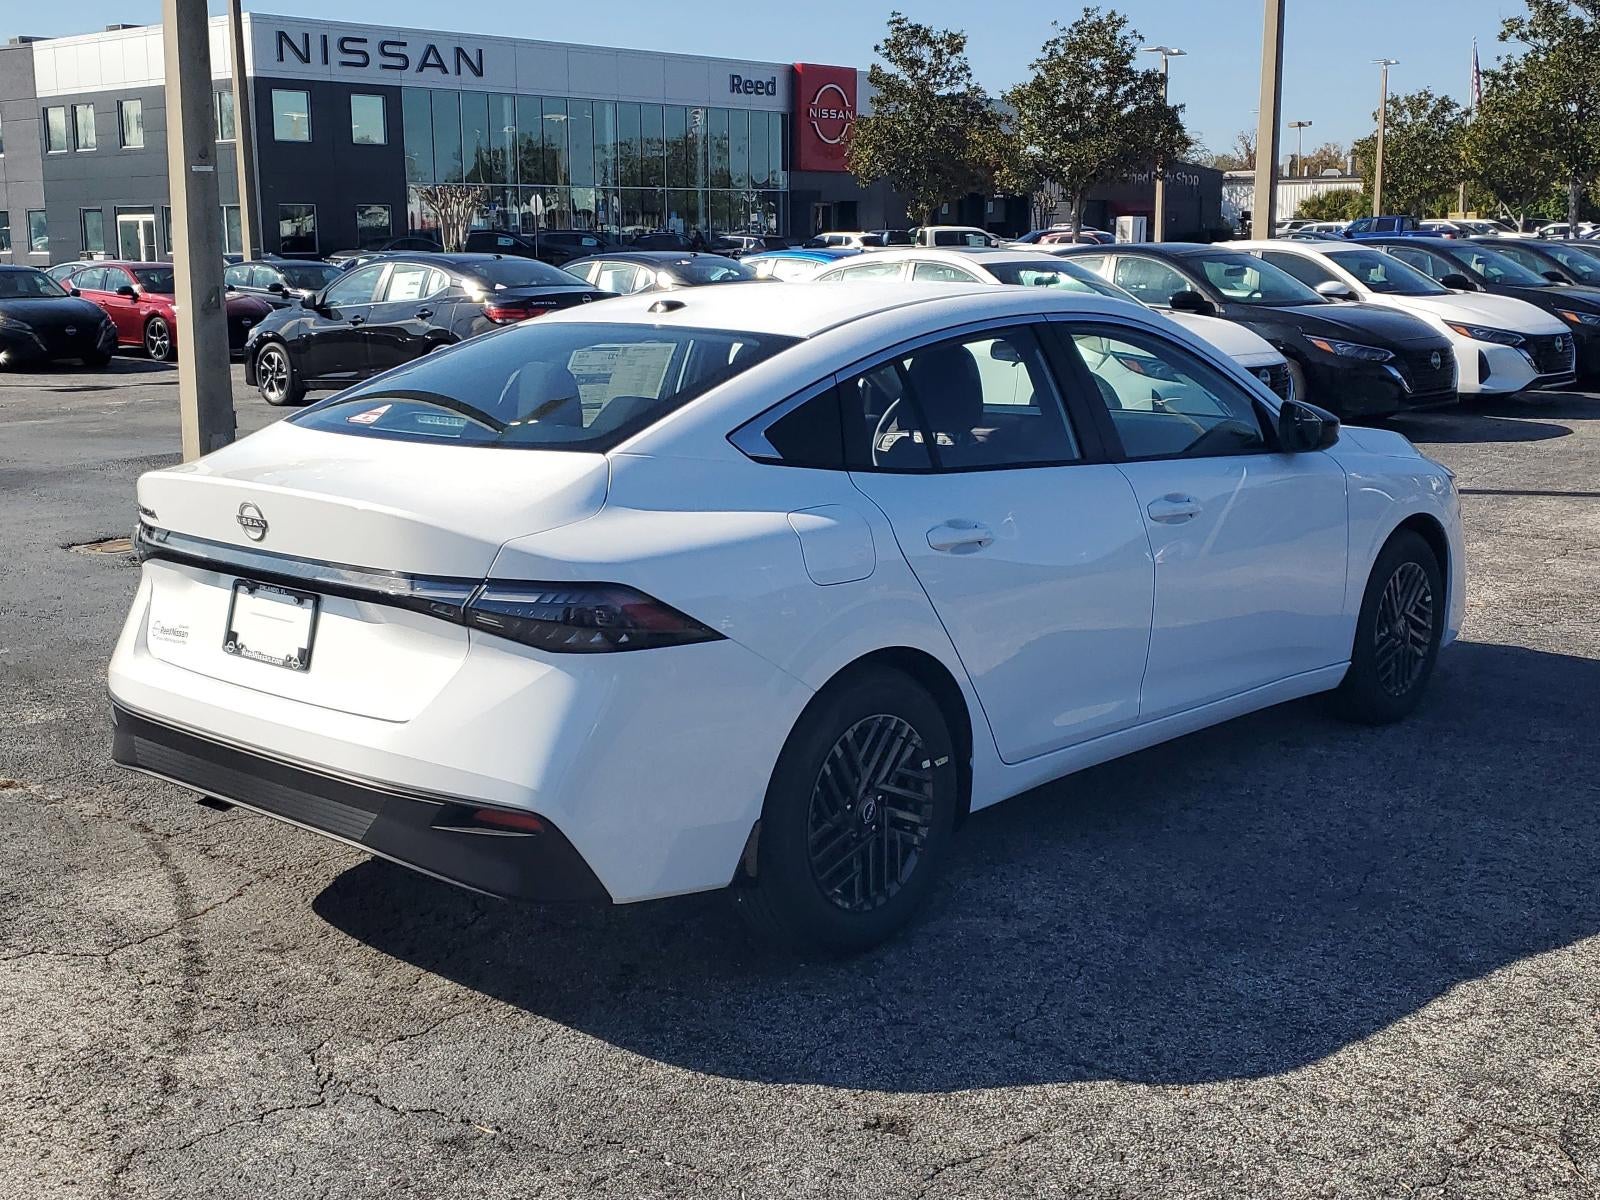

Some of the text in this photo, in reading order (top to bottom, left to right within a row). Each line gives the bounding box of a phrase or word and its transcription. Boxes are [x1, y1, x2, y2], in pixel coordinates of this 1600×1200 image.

[275, 30, 484, 77] NISSAN
[729, 73, 777, 96] Reed
[809, 107, 853, 120] NISSAN
